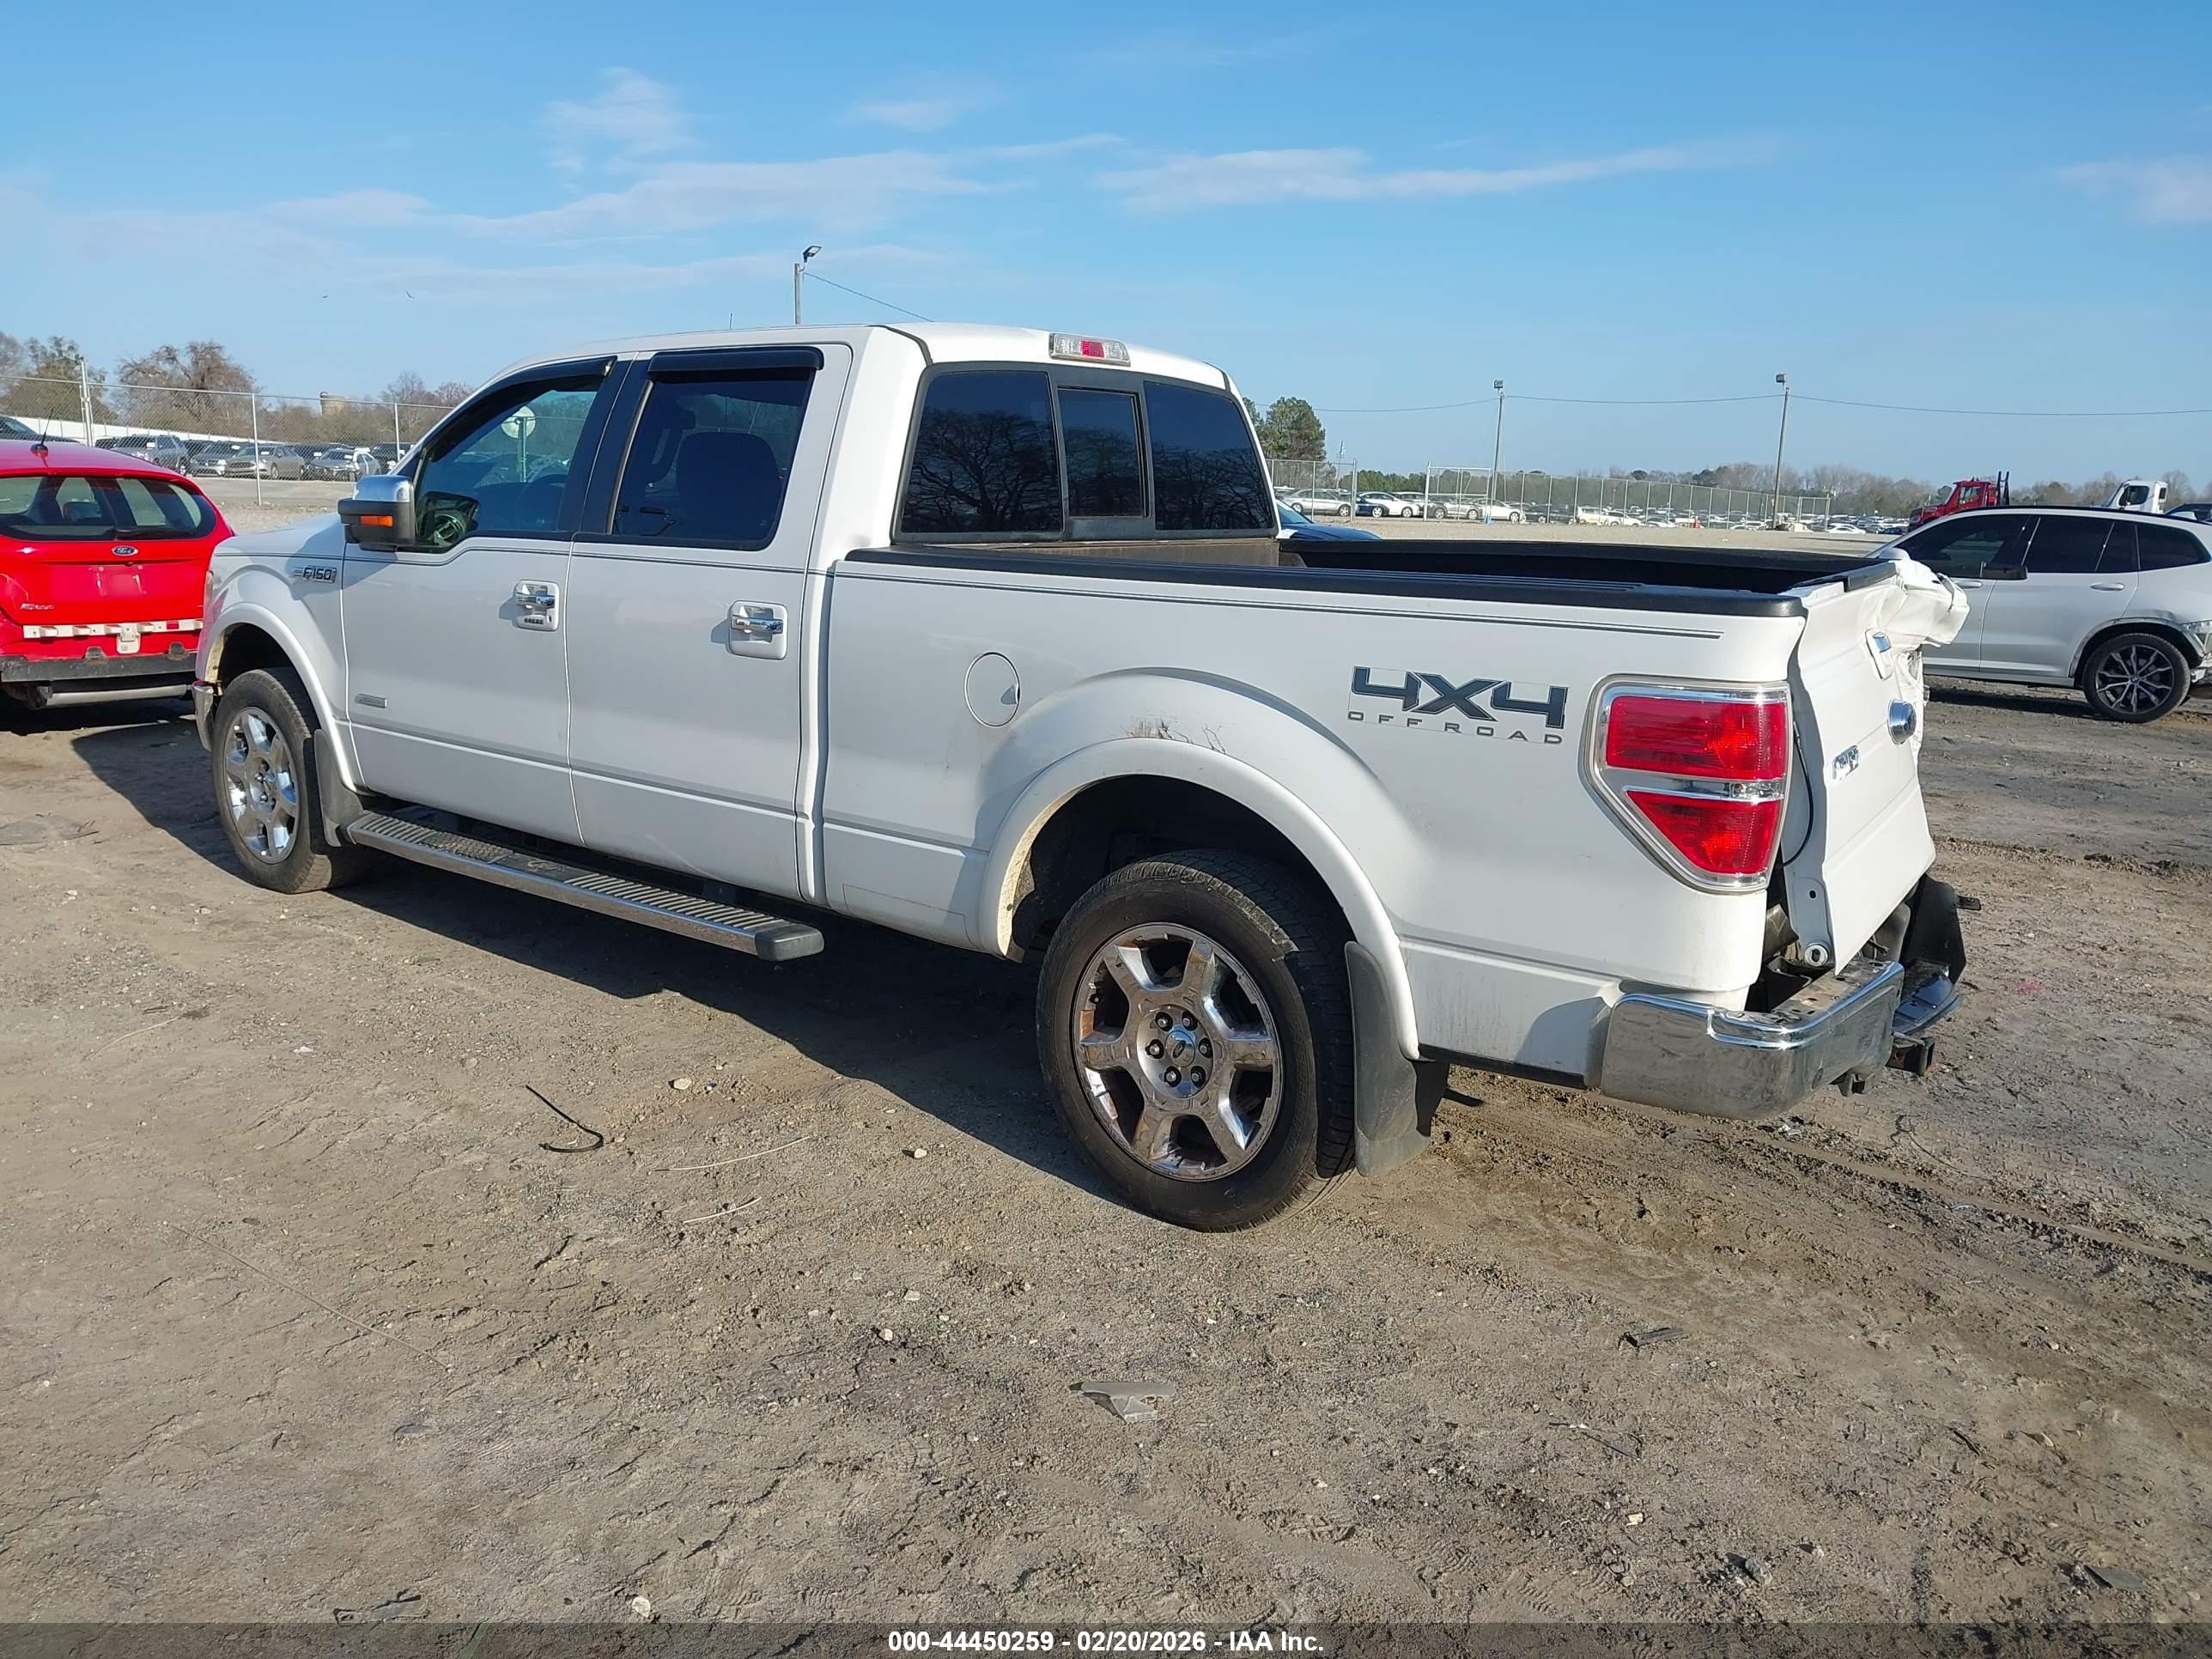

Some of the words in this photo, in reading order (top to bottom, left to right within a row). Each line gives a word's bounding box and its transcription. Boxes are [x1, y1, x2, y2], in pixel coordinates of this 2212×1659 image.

[1351, 665, 1569, 729] 4X4
[1347, 710, 1423, 728] OFF
[1443, 721, 1563, 744] ROAD
